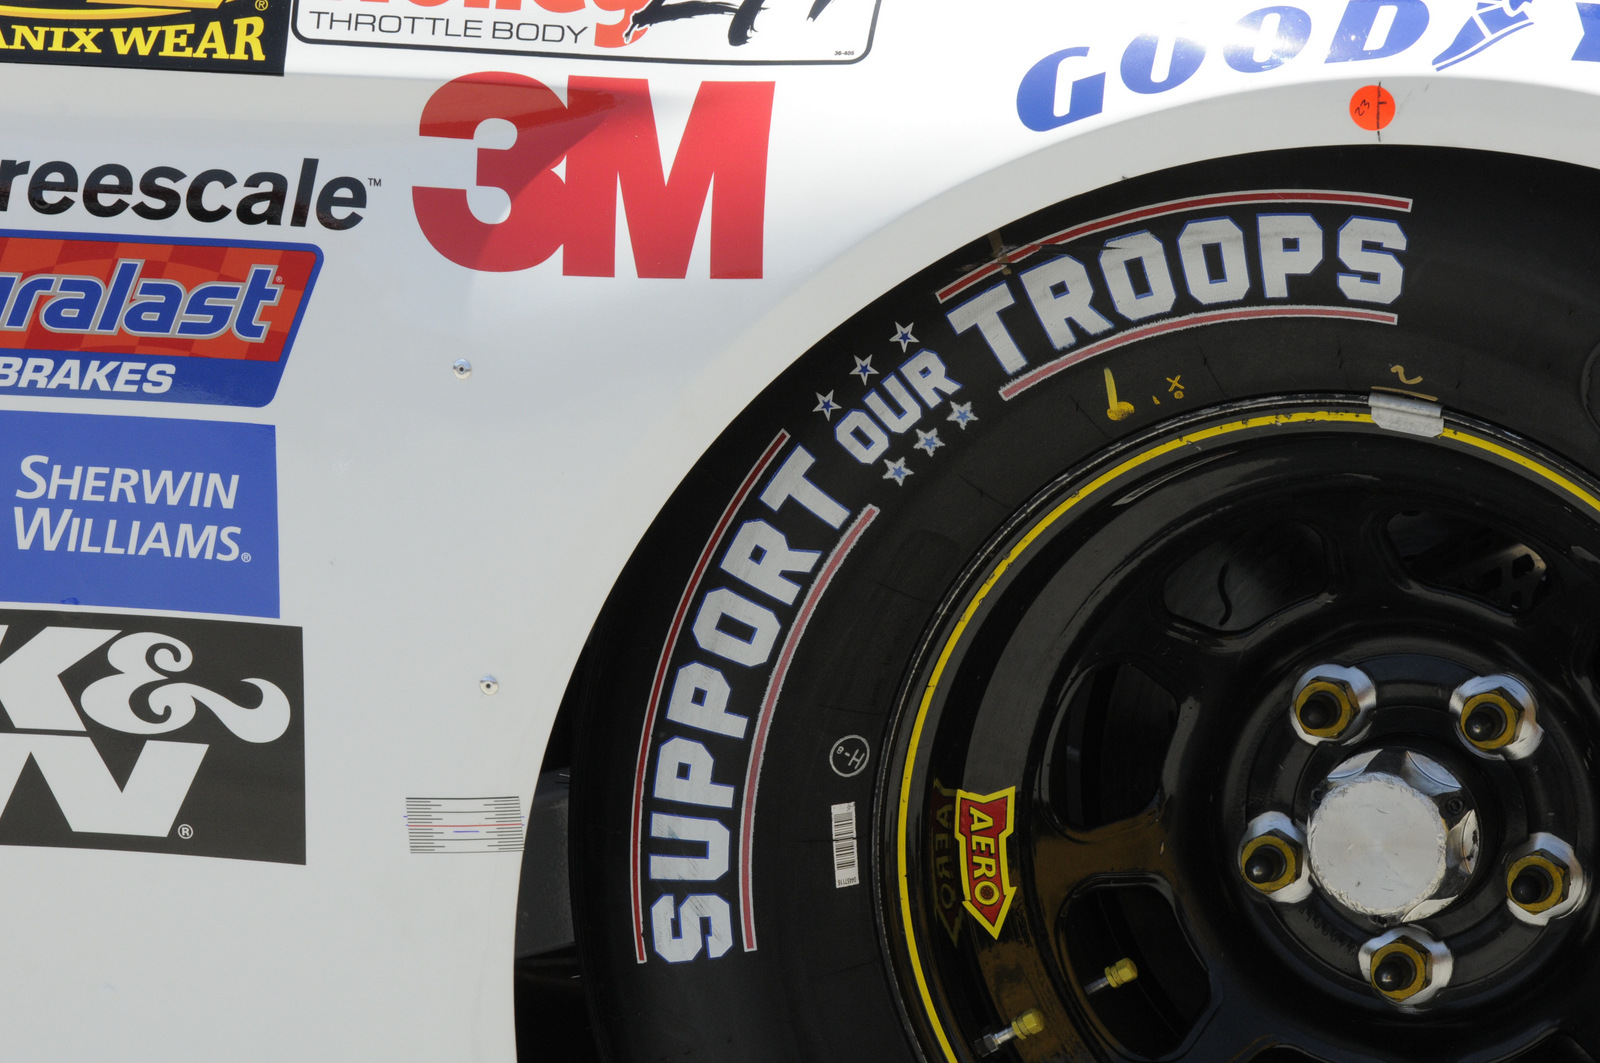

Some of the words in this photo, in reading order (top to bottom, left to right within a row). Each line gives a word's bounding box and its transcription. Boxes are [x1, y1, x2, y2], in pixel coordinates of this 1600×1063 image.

[0, 24, 103, 53] NIX
[110, 16, 265, 61] WEAR
[309, 11, 483, 38] THROTTLE
[492, 20, 588, 44] BODY
[412, 71, 776, 279] 3M
[0, 356, 176, 394] BRAKES
[15, 454, 240, 509] SHERWIN
[13, 506, 242, 562] WILLIAMS
[649, 443, 851, 963] SUPPORT
[834, 348, 963, 465] OUR
[945, 211, 1409, 376] TROOPS
[969, 805, 1000, 906] AERO
